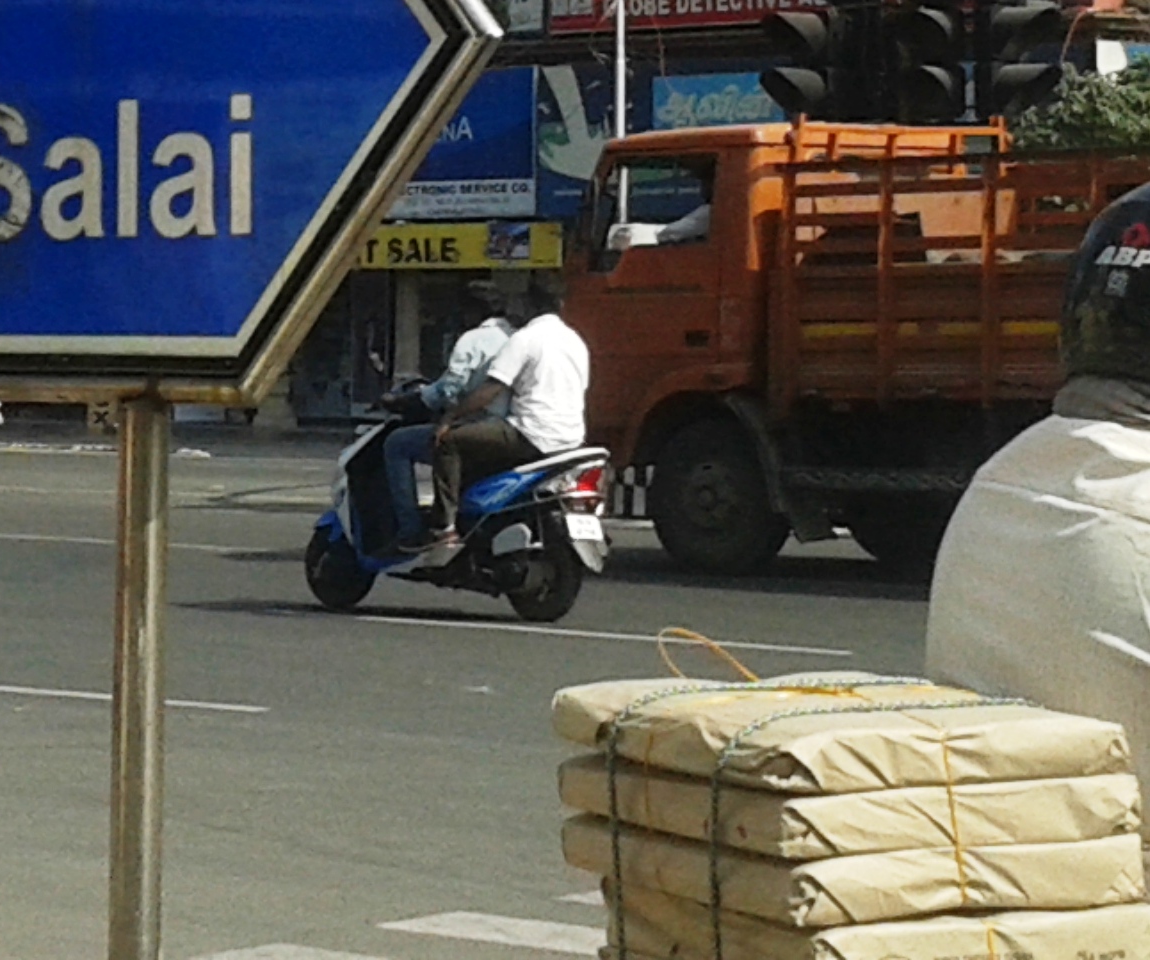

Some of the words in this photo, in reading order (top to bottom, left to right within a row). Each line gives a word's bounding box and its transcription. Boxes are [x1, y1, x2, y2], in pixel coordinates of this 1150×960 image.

[405, 184, 457, 195] CTRONIC
[459, 183, 508, 194] SERVICE
[386, 238, 461, 264] SALE
